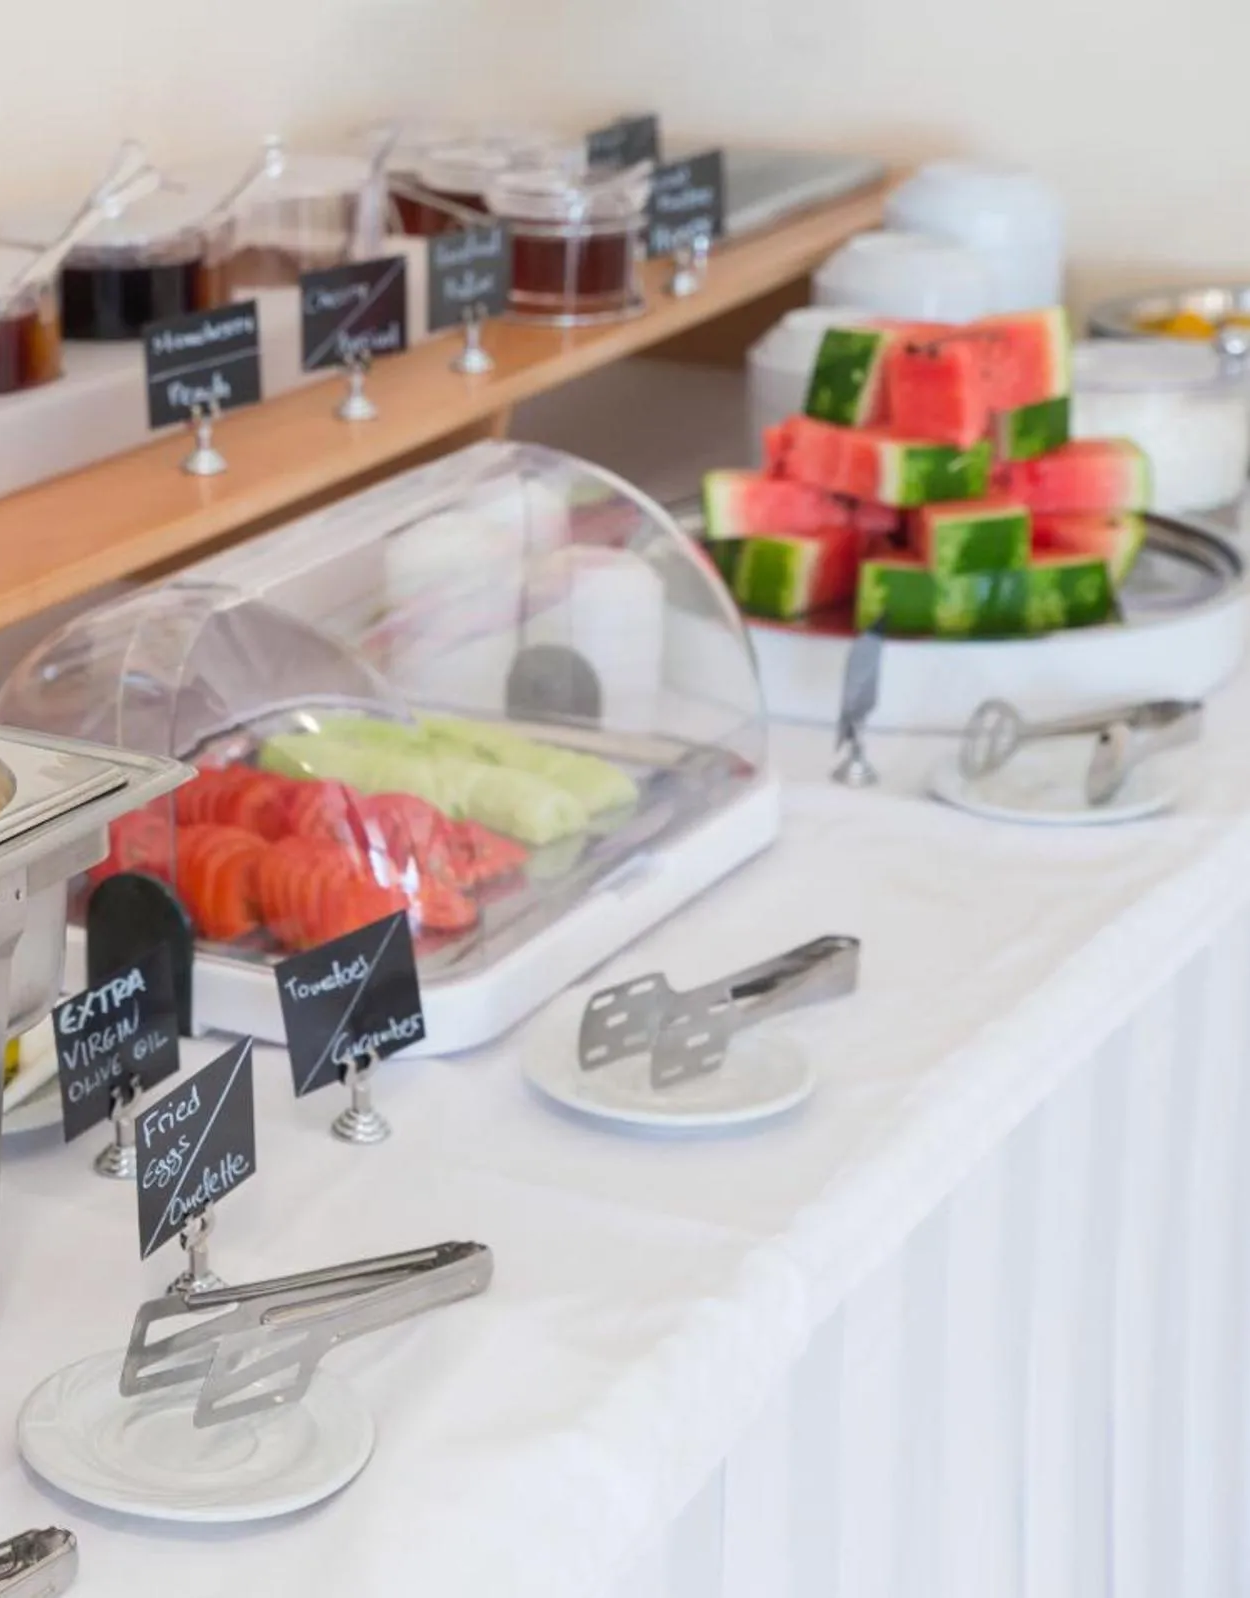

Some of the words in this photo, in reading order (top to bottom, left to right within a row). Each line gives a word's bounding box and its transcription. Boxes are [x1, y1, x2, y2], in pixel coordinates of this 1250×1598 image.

[59, 967, 147, 1034] EXTRA
[284, 954, 370, 1003] Tomatoes
[63, 998, 140, 1070] VIRGIN
[68, 1052, 122, 1103] OLIVE
[133, 1031, 169, 1061] OIL
[142, 1083, 201, 1149] Fried
[143, 1133, 191, 1190] Eggs
